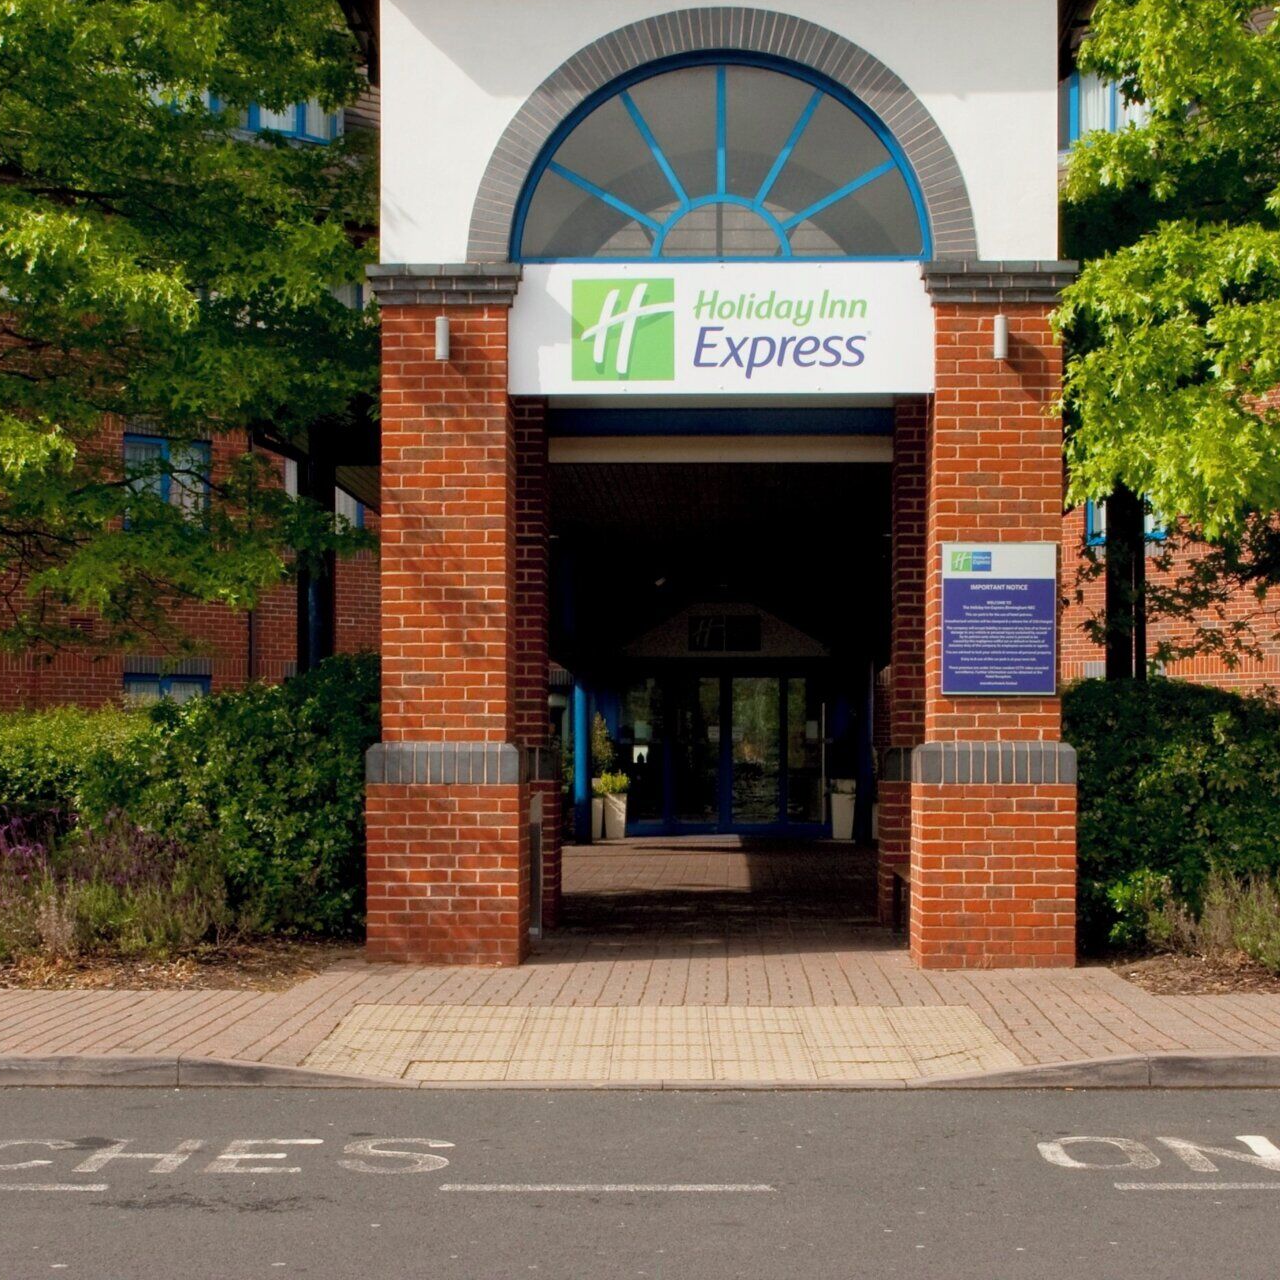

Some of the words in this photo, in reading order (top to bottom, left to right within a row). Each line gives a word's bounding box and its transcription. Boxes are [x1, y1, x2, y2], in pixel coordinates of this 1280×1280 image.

[693, 289, 813, 327] Holiday
[819, 289, 868, 319] Inn
[693, 326, 866, 380] Express
